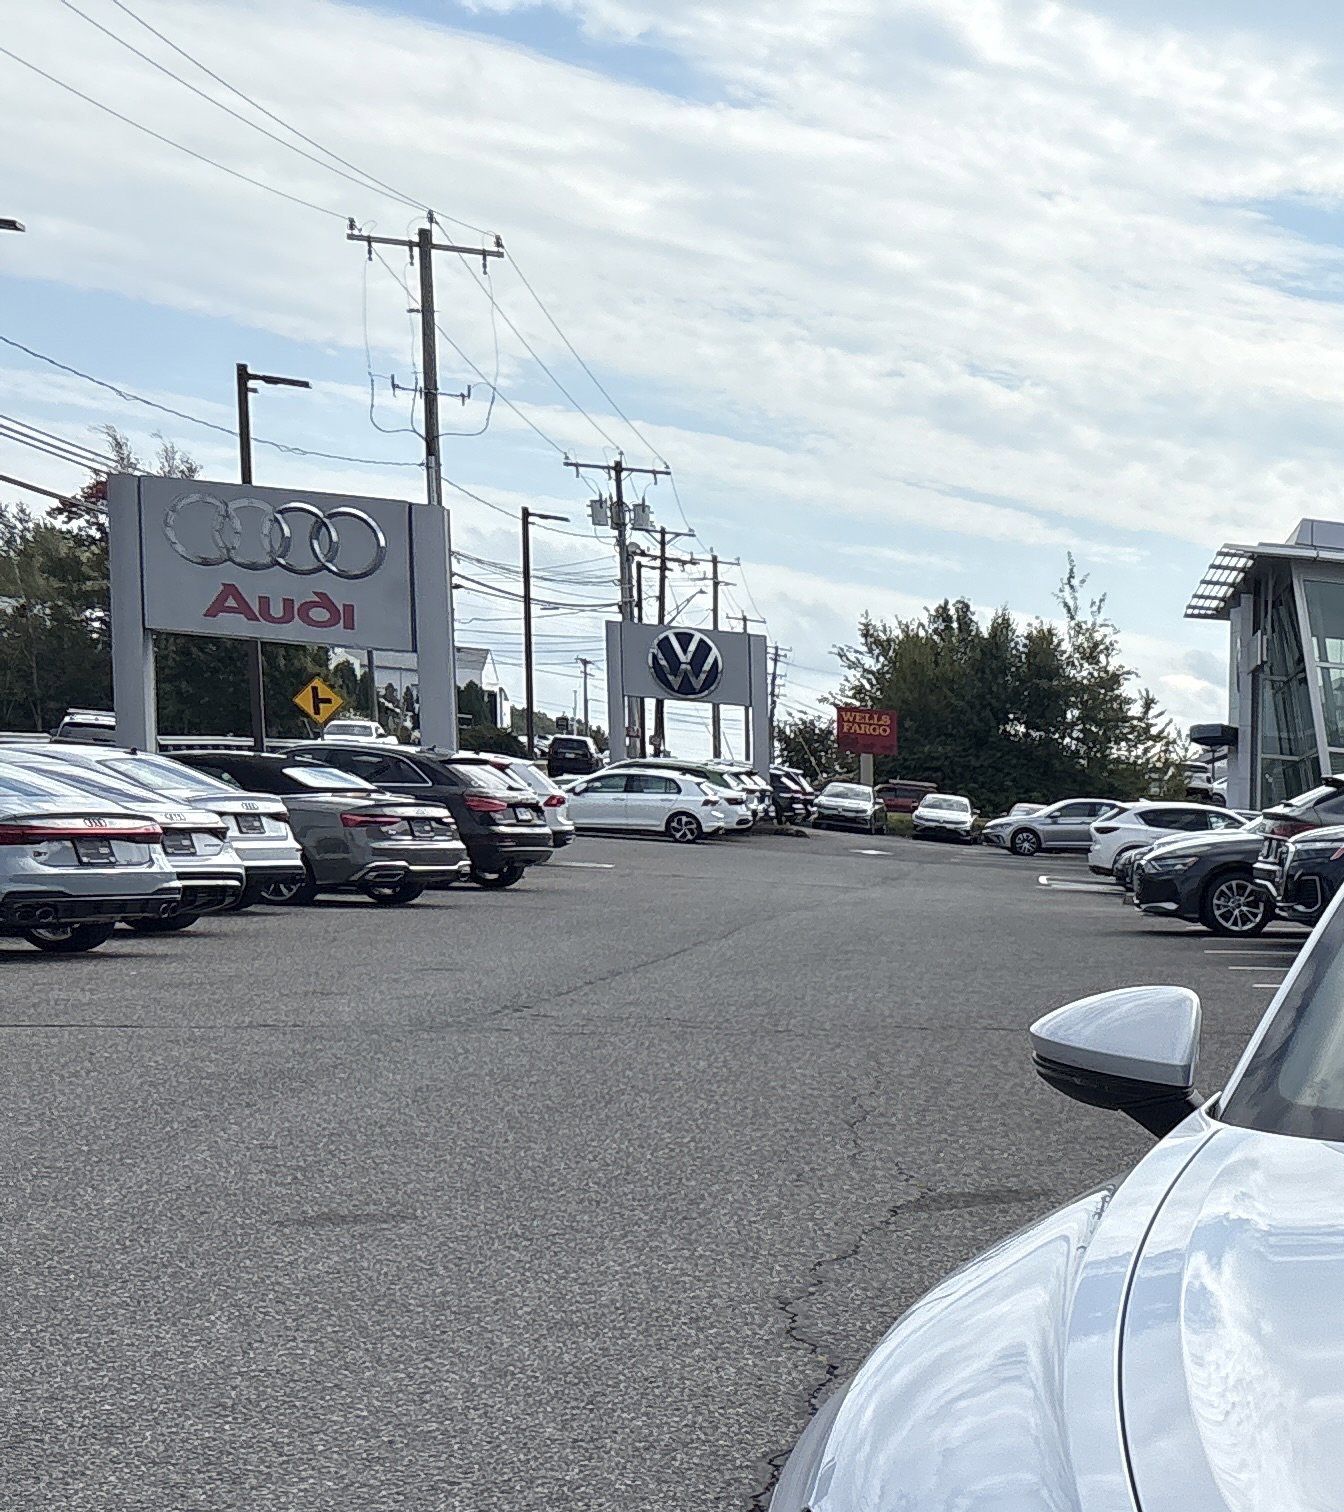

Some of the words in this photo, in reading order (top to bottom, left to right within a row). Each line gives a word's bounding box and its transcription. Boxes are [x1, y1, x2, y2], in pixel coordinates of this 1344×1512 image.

[203, 582, 355, 630] Audi
[841, 711, 891, 725] WELLS
[842, 722, 891, 736] FARGO
